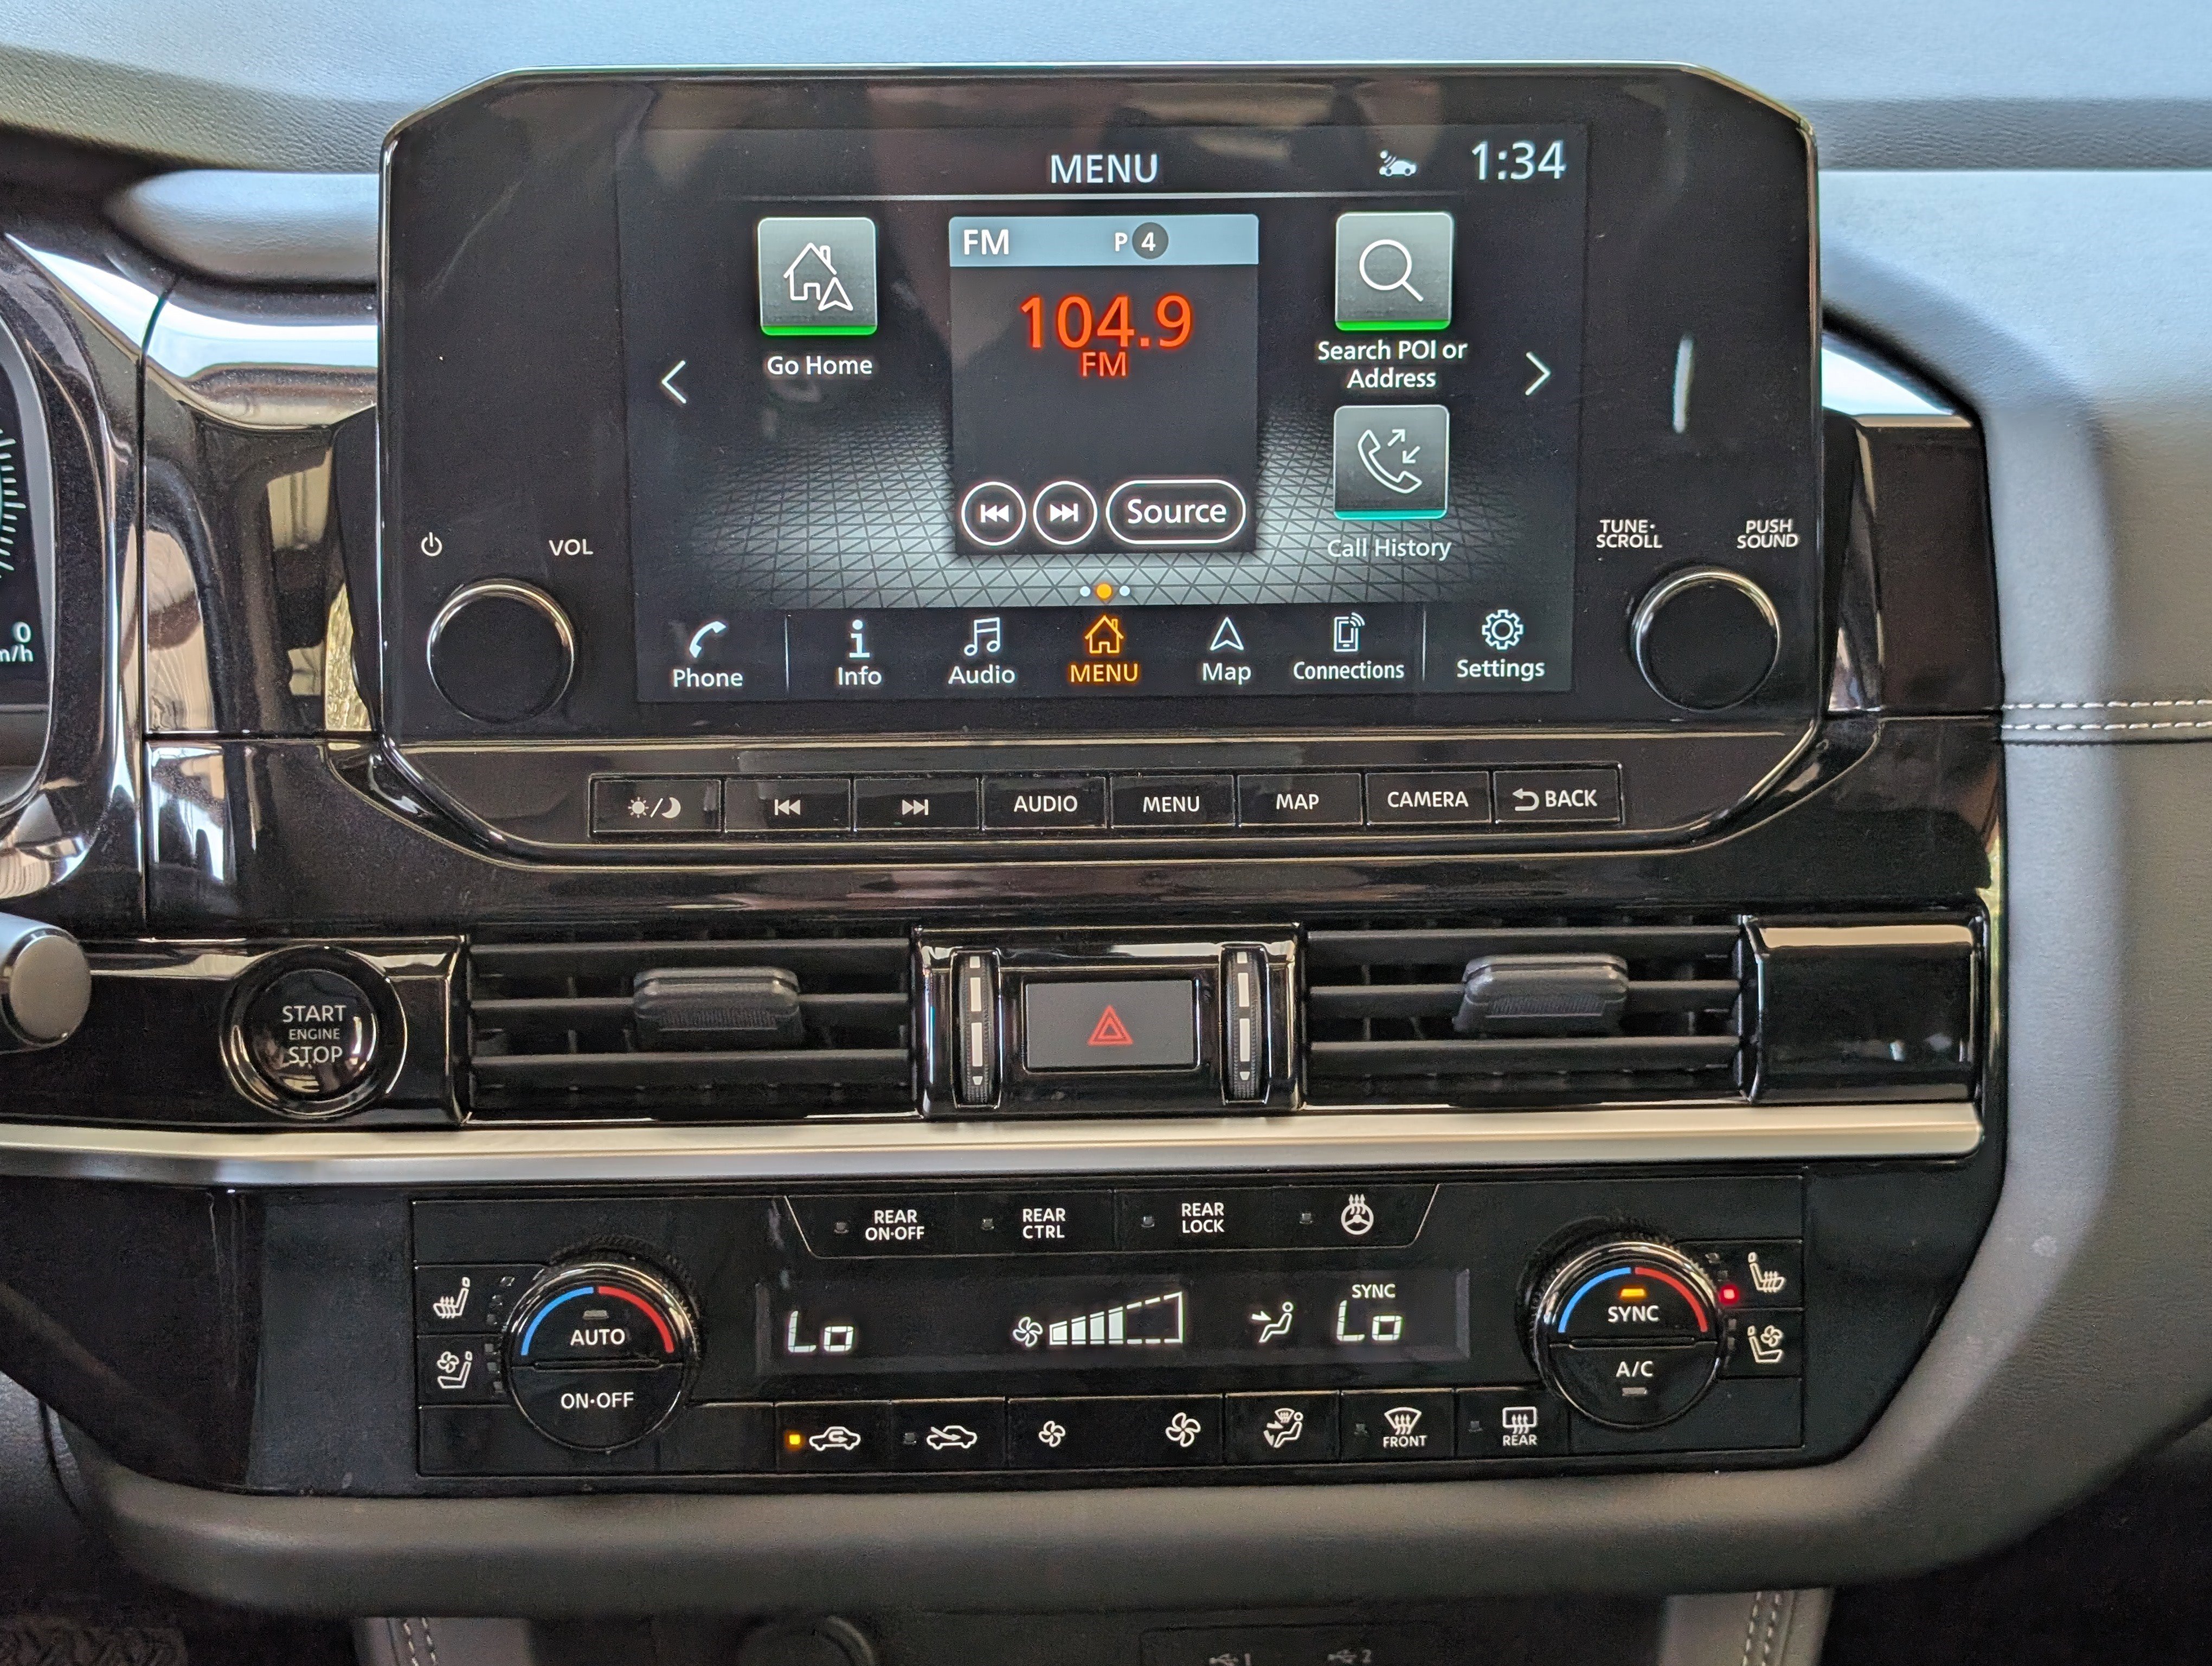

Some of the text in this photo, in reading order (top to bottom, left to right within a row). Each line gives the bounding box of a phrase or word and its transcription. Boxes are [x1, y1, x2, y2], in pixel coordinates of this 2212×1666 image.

[1051, 153, 1158, 183] MENU
[1472, 140, 1566, 180] 1:34
[963, 229, 1009, 255] FM
[1115, 232, 1156, 252] P 4
[1020, 294, 1192, 349] 104.9
[1318, 339, 1468, 361] Search POI or
[767, 355, 872, 375] Go Home
[1081, 351, 1126, 377] FM
[1347, 367, 1436, 388] Address
[1127, 498, 1227, 524] Source
[1746, 518, 1792, 534] PUSH
[549, 539, 594, 556] VOL
[1327, 538, 1452, 561] Call History
[1596, 534, 1663, 548] SCROLL
[1737, 533, 1799, 549] SOUND
[14, 622, 31, 643] 0
[673, 667, 743, 687] Phone
[838, 665, 882, 685] Info
[948, 664, 1015, 684] Audio
[1070, 663, 1138, 682] MENU
[1203, 662, 1251, 685] Map
[1293, 660, 1405, 680] Connections
[1457, 658, 1545, 682] Settings
[1013, 795, 1078, 812] AUDIO
[1143, 796, 1200, 813] MENU
[1276, 793, 1319, 810] MAP
[1387, 791, 1469, 808] CAMERA
[1545, 789, 1597, 808] BACK
[282, 1004, 346, 1023] START
[289, 1028, 340, 1040] ENGINE
[288, 1046, 343, 1063] STOP
[874, 1209, 917, 1224] REAR
[1023, 1208, 1066, 1222] REAR
[1181, 1202, 1224, 1217] REAR
[1023, 1225, 1065, 1239] CTRL
[1182, 1219, 1225, 1233] LOCK
[1352, 1283, 1396, 1298] SYNC
[1607, 1305, 1659, 1323] SYNC
[570, 1328, 625, 1346] AUTO
[1616, 1360, 1653, 1377] A/C
[1383, 1435, 1427, 1447] FRONT
[1503, 1434, 1537, 1446] REAR
